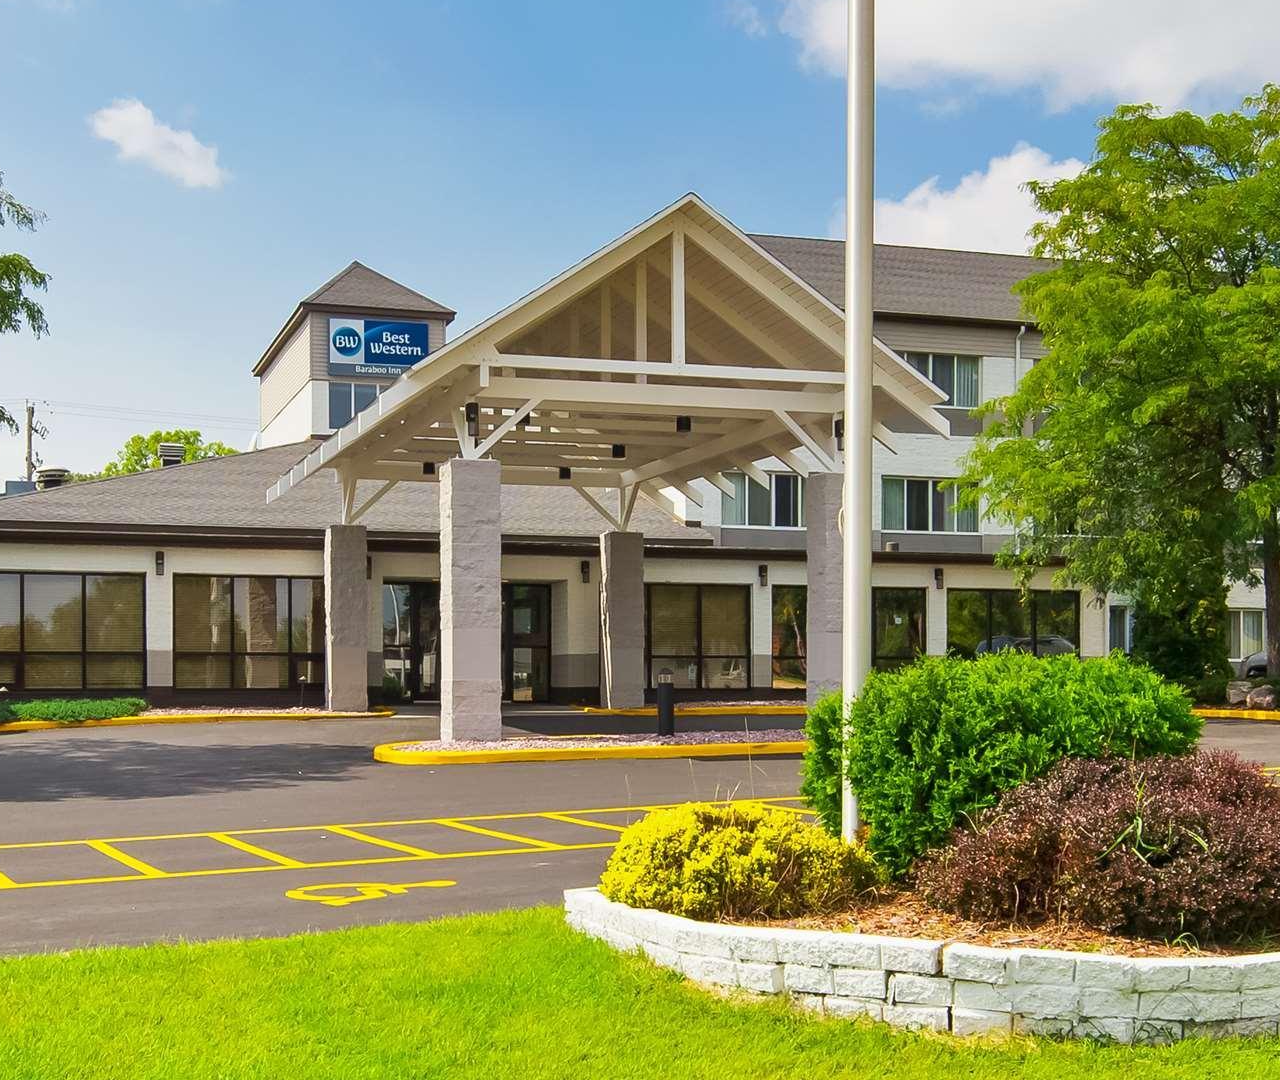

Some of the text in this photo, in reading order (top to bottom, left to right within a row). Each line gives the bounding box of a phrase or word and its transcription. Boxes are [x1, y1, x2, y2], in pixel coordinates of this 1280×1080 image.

[336, 335, 358, 348] BW
[382, 331, 410, 344] Best
[370, 342, 421, 355] Western
[355, 365, 401, 374] Baraboo Inn
